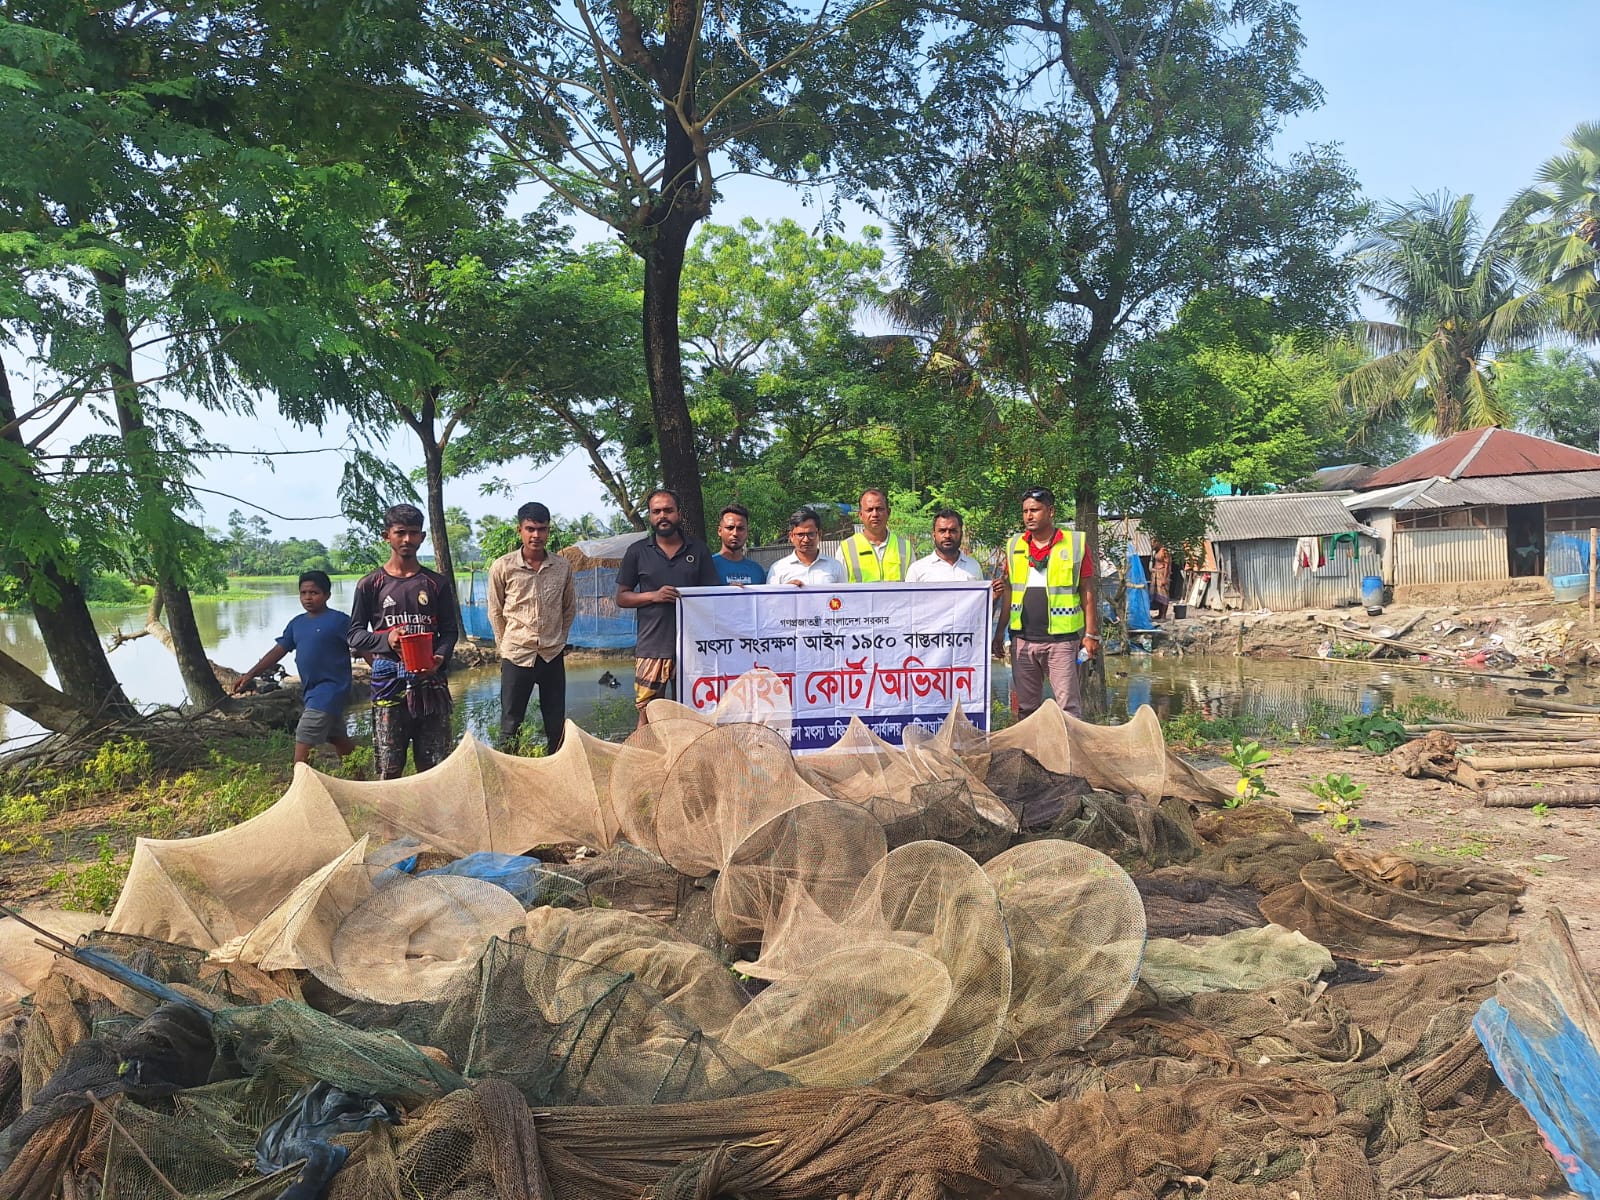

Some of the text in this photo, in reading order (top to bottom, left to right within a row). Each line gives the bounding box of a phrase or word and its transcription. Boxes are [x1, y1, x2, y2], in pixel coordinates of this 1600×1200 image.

[384, 611, 432, 627] Emirates
[824, 616, 861, 627] বাংলাদেশ
[863, 616, 890, 625] সরকার
[695, 630, 975, 656] মৎস্য সংরক্ষণ আইন ১৯৫০ বাস্তবায়নে
[692, 661, 796, 709] মোবাইল
[803, 725, 826, 741] মৎস্য
